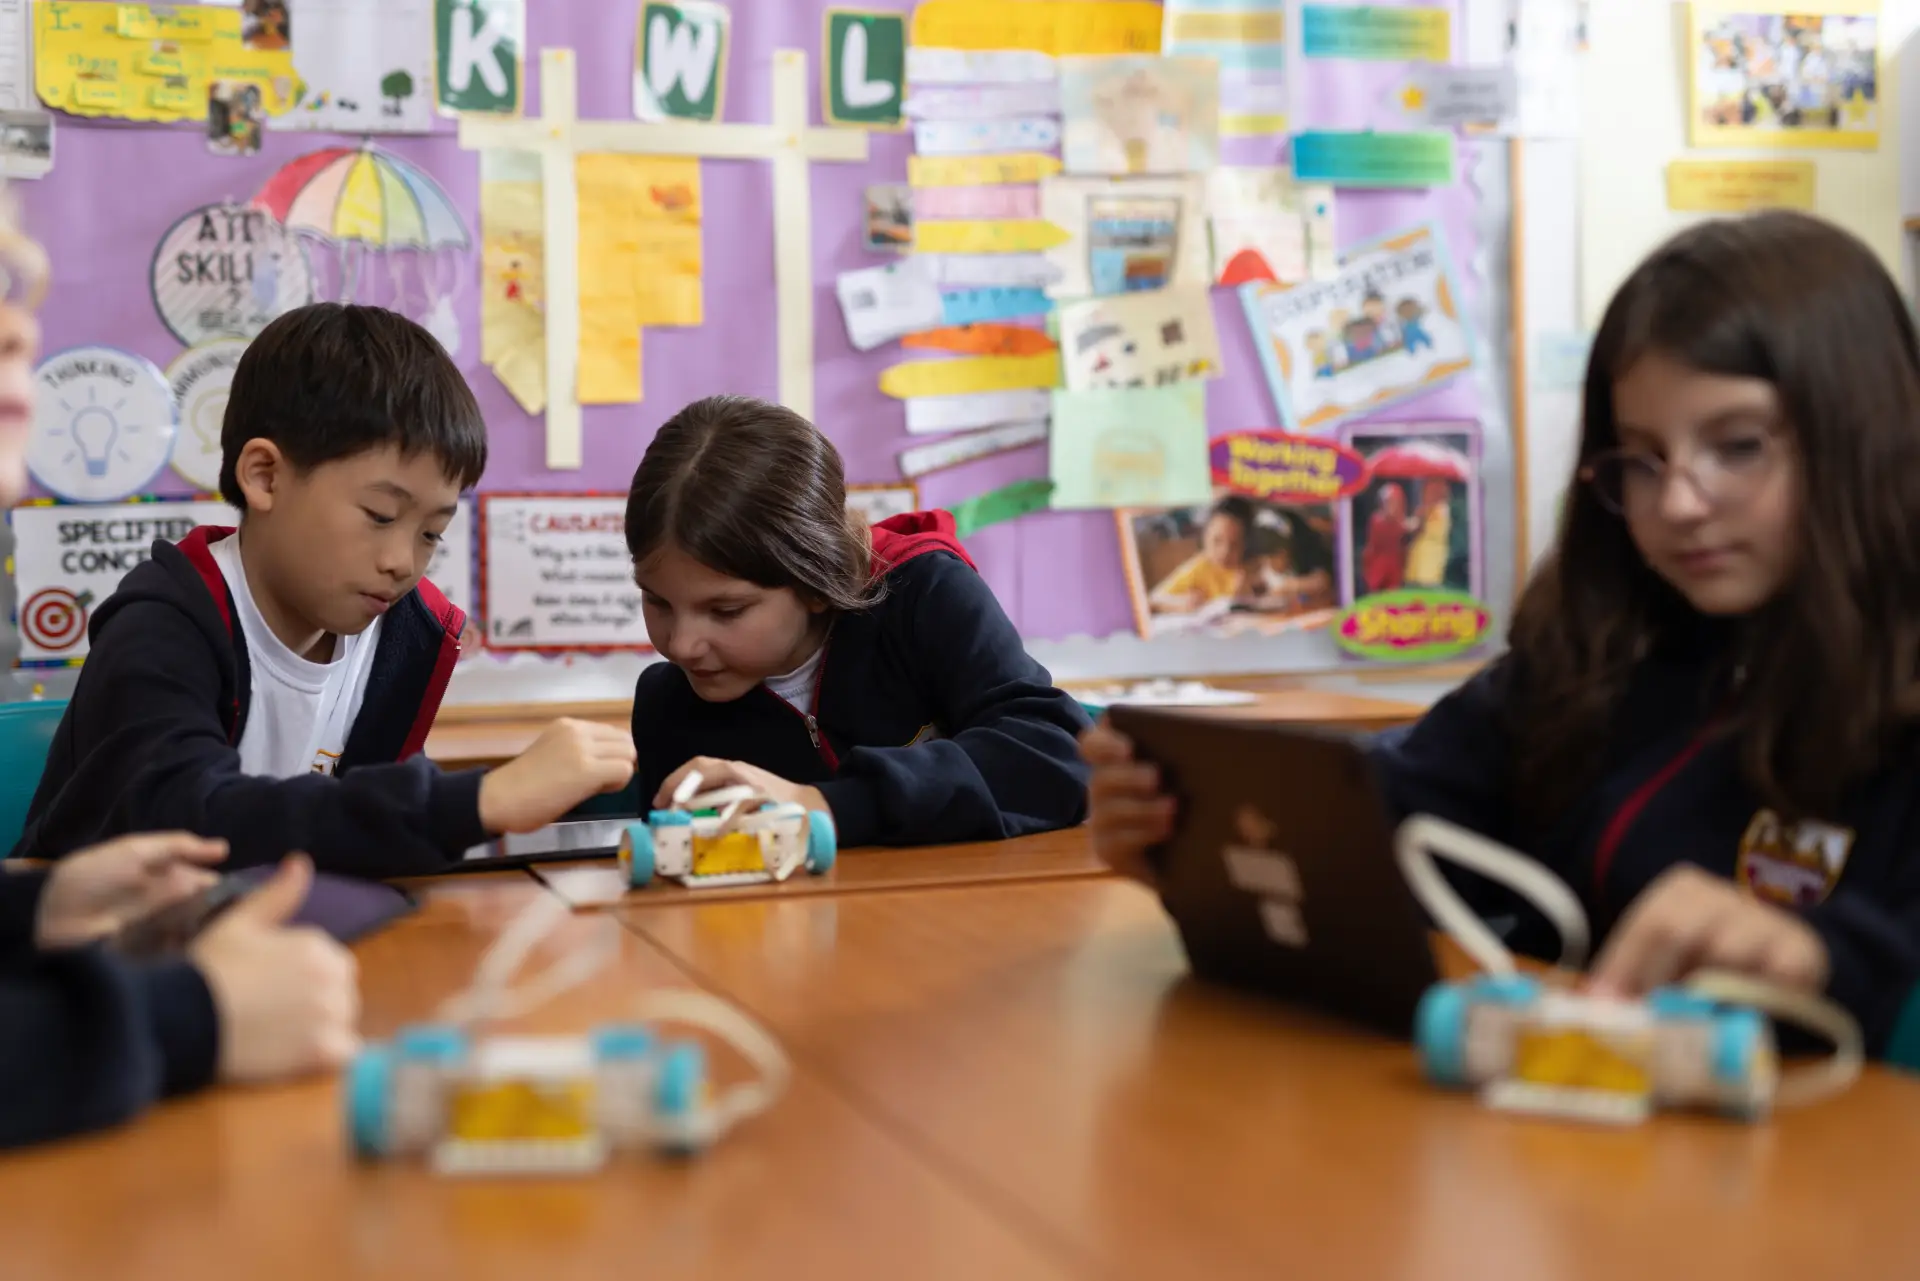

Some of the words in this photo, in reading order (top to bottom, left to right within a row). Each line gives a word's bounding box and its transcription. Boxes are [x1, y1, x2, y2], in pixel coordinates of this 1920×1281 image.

[447, 4, 509, 98] K
[647, 12, 718, 103] W
[840, 22, 897, 107] L
[43, 356, 137, 389] THINKING
[1228, 435, 1338, 476] Working
[1229, 455, 1343, 497] Together
[58, 518, 195, 545] SPECIFIED
[529, 512, 626, 533] CAUSATI
[61, 549, 152, 574] CONCE
[1358, 604, 1476, 645] Sharing
